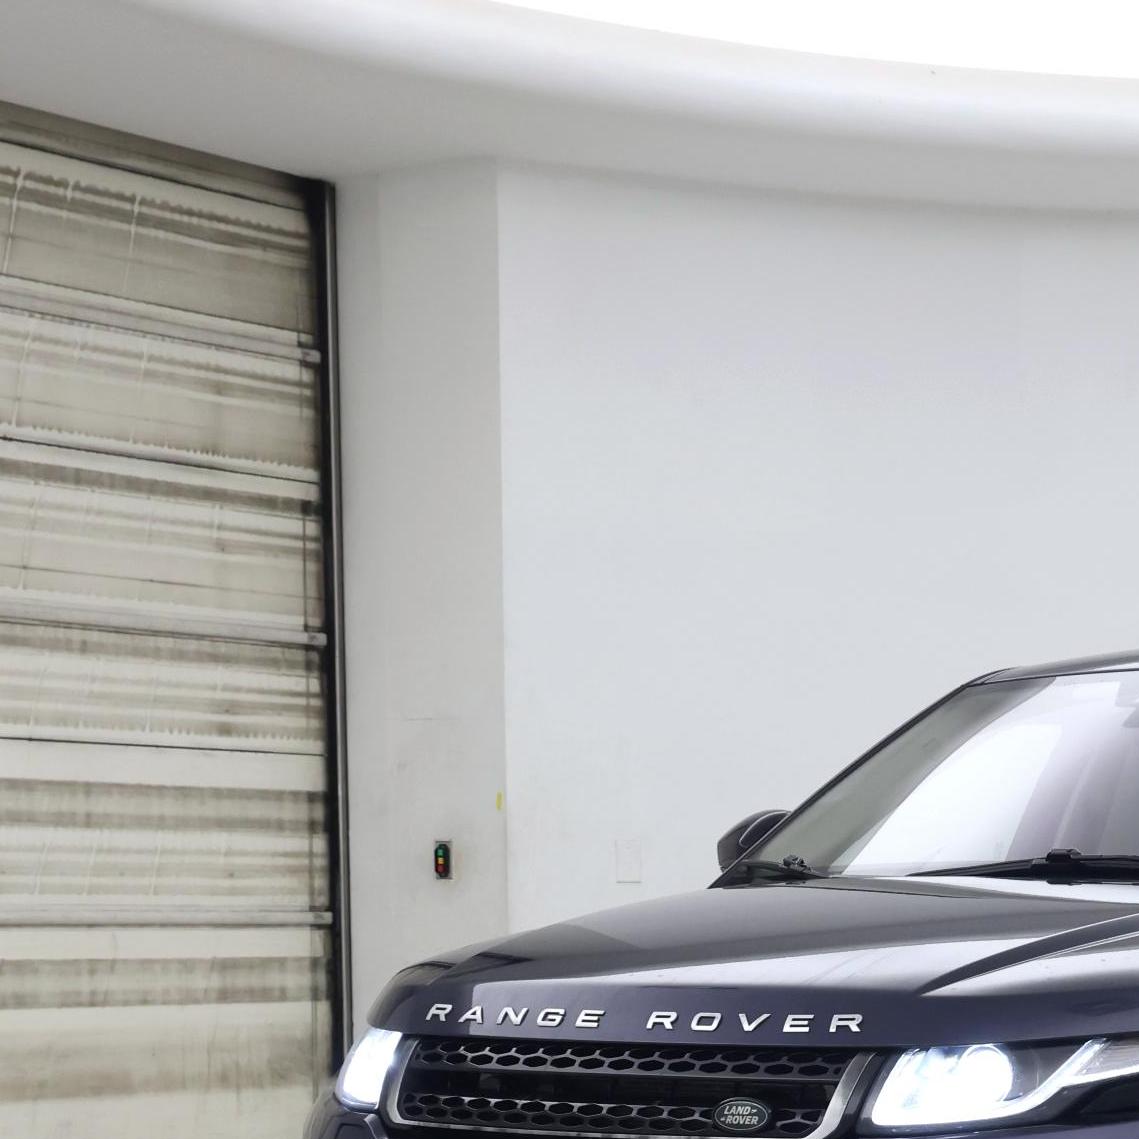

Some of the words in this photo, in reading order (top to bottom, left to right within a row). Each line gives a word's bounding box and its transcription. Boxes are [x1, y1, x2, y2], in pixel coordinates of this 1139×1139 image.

[424, 1003, 605, 1029] RANGE
[646, 1011, 865, 1033] ROVER
[724, 1105, 752, 1115] LAND
[725, 1115, 759, 1125] ROVER
